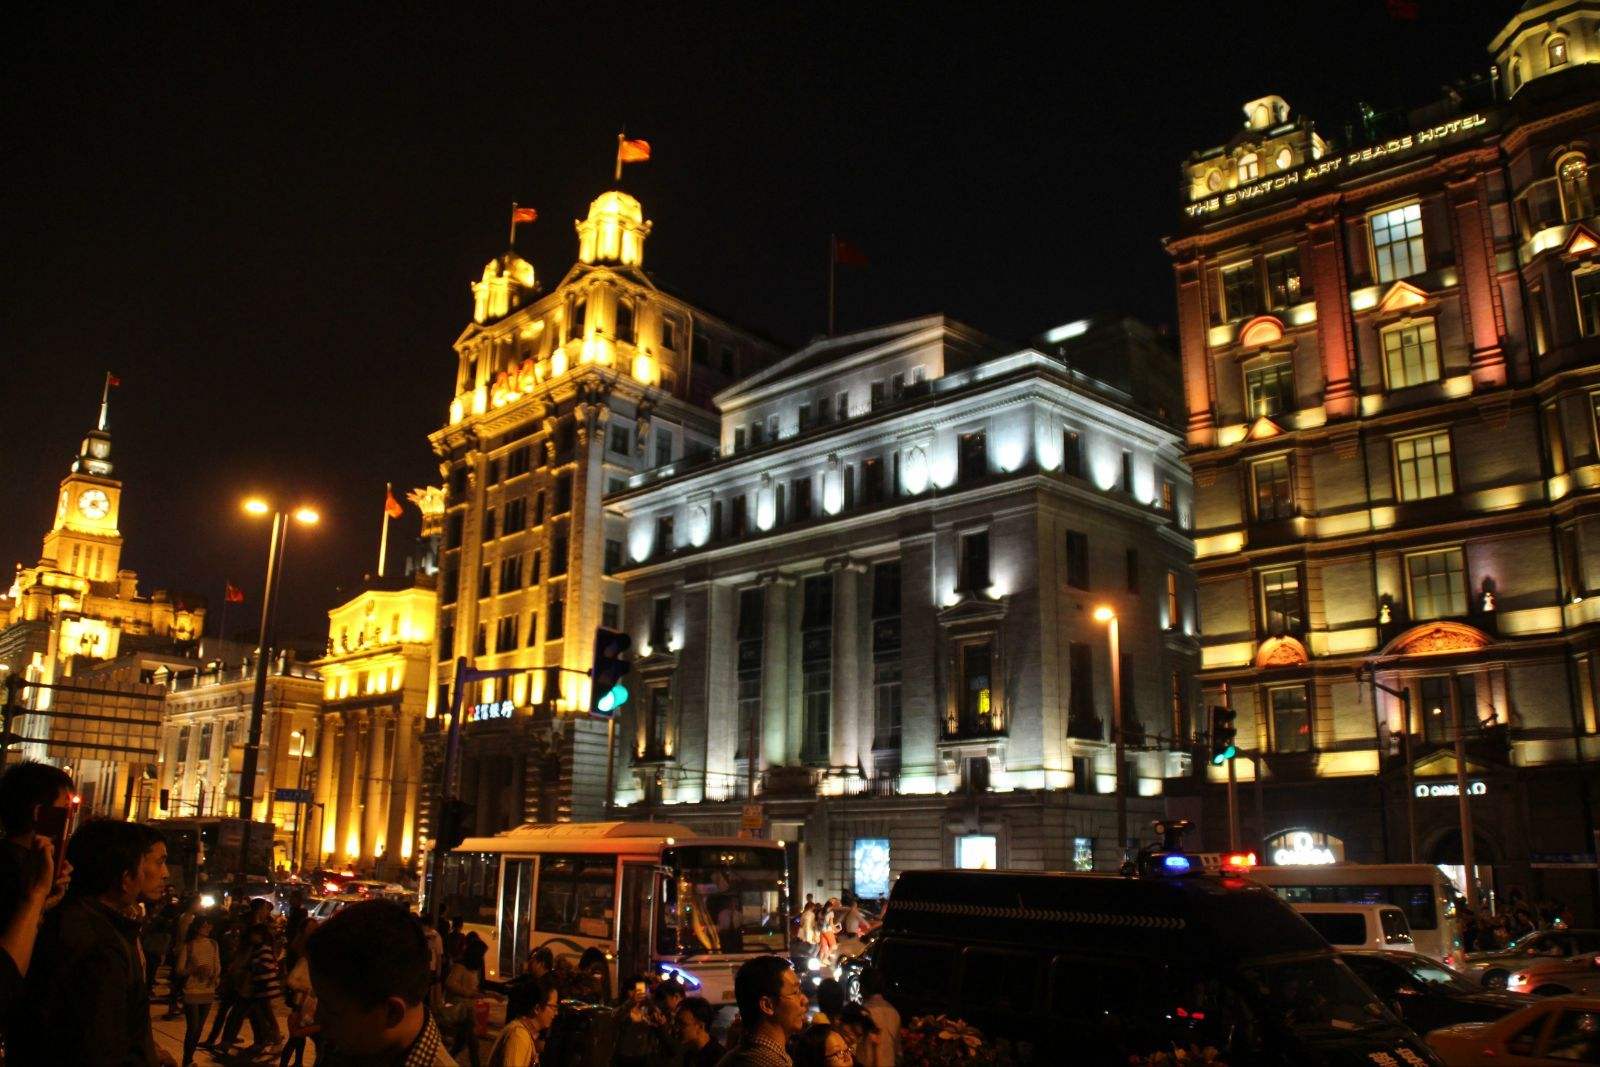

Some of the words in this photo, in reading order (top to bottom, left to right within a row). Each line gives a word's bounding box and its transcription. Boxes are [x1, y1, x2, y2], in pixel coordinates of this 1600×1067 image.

[1185, 198, 1220, 216] THE
[1225, 172, 1299, 204] SWATCH
[1303, 158, 1342, 181] ART
[1348, 135, 1413, 166] PEACE
[1418, 114, 1487, 143] HOTEL
